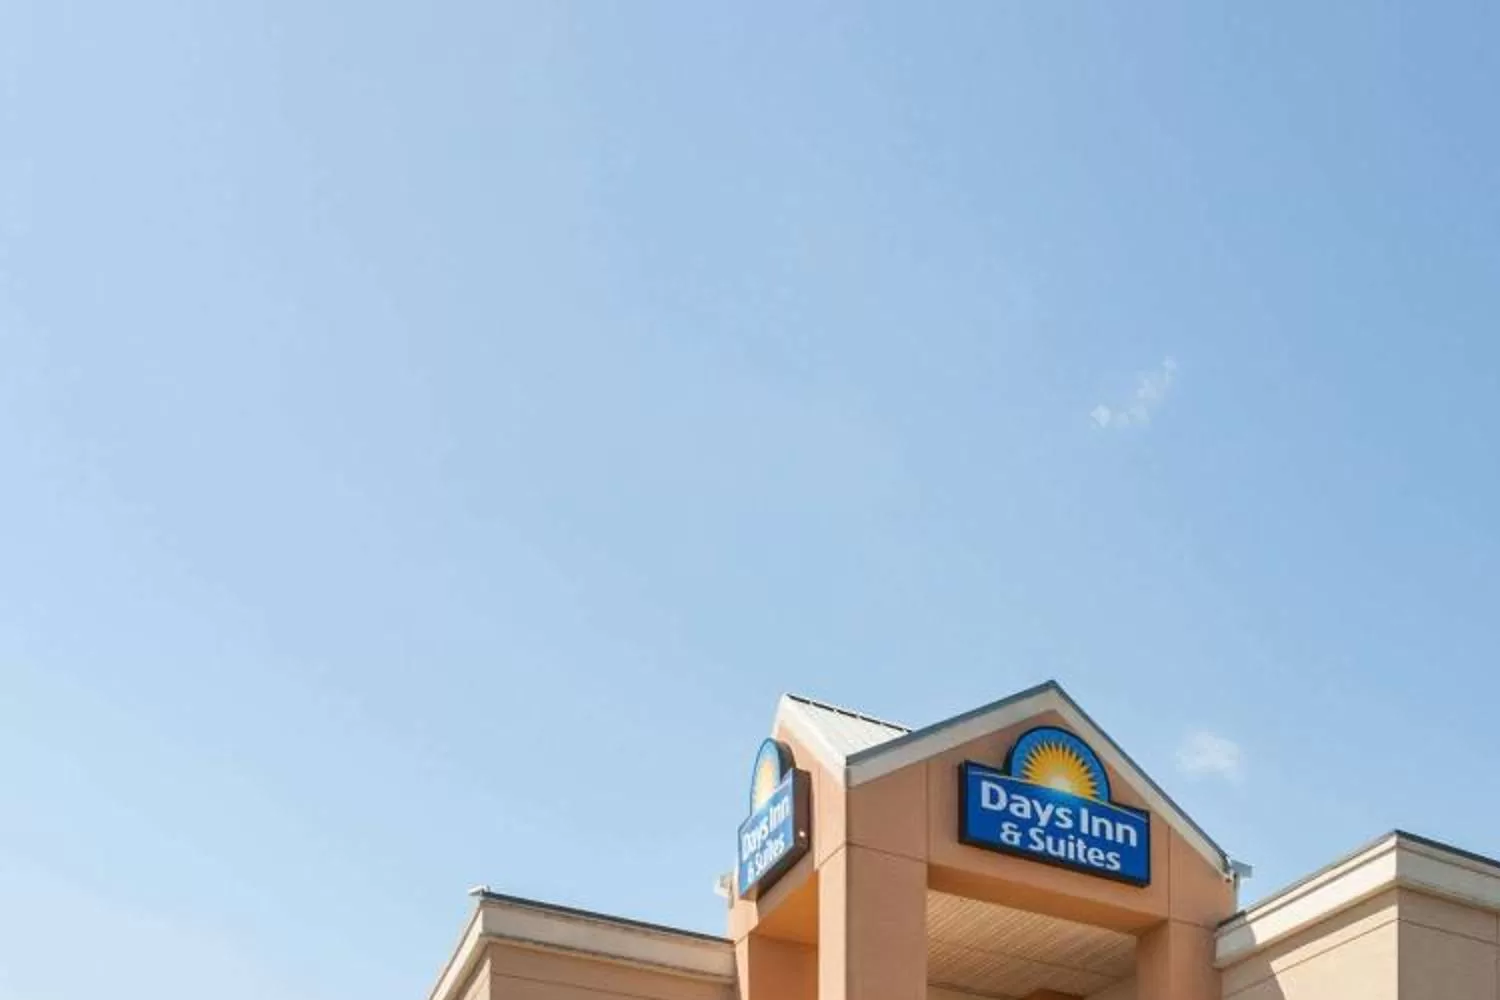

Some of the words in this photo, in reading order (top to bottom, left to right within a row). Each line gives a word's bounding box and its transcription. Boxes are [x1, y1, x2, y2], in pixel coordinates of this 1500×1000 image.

[741, 815, 769, 862] Days
[769, 795, 790, 833] Inn
[980, 780, 1074, 829] Days
[1080, 807, 1138, 848] Inn
[755, 832, 785, 877] Suites
[1000, 821, 1022, 847] &
[1028, 827, 1121, 871] Suites
